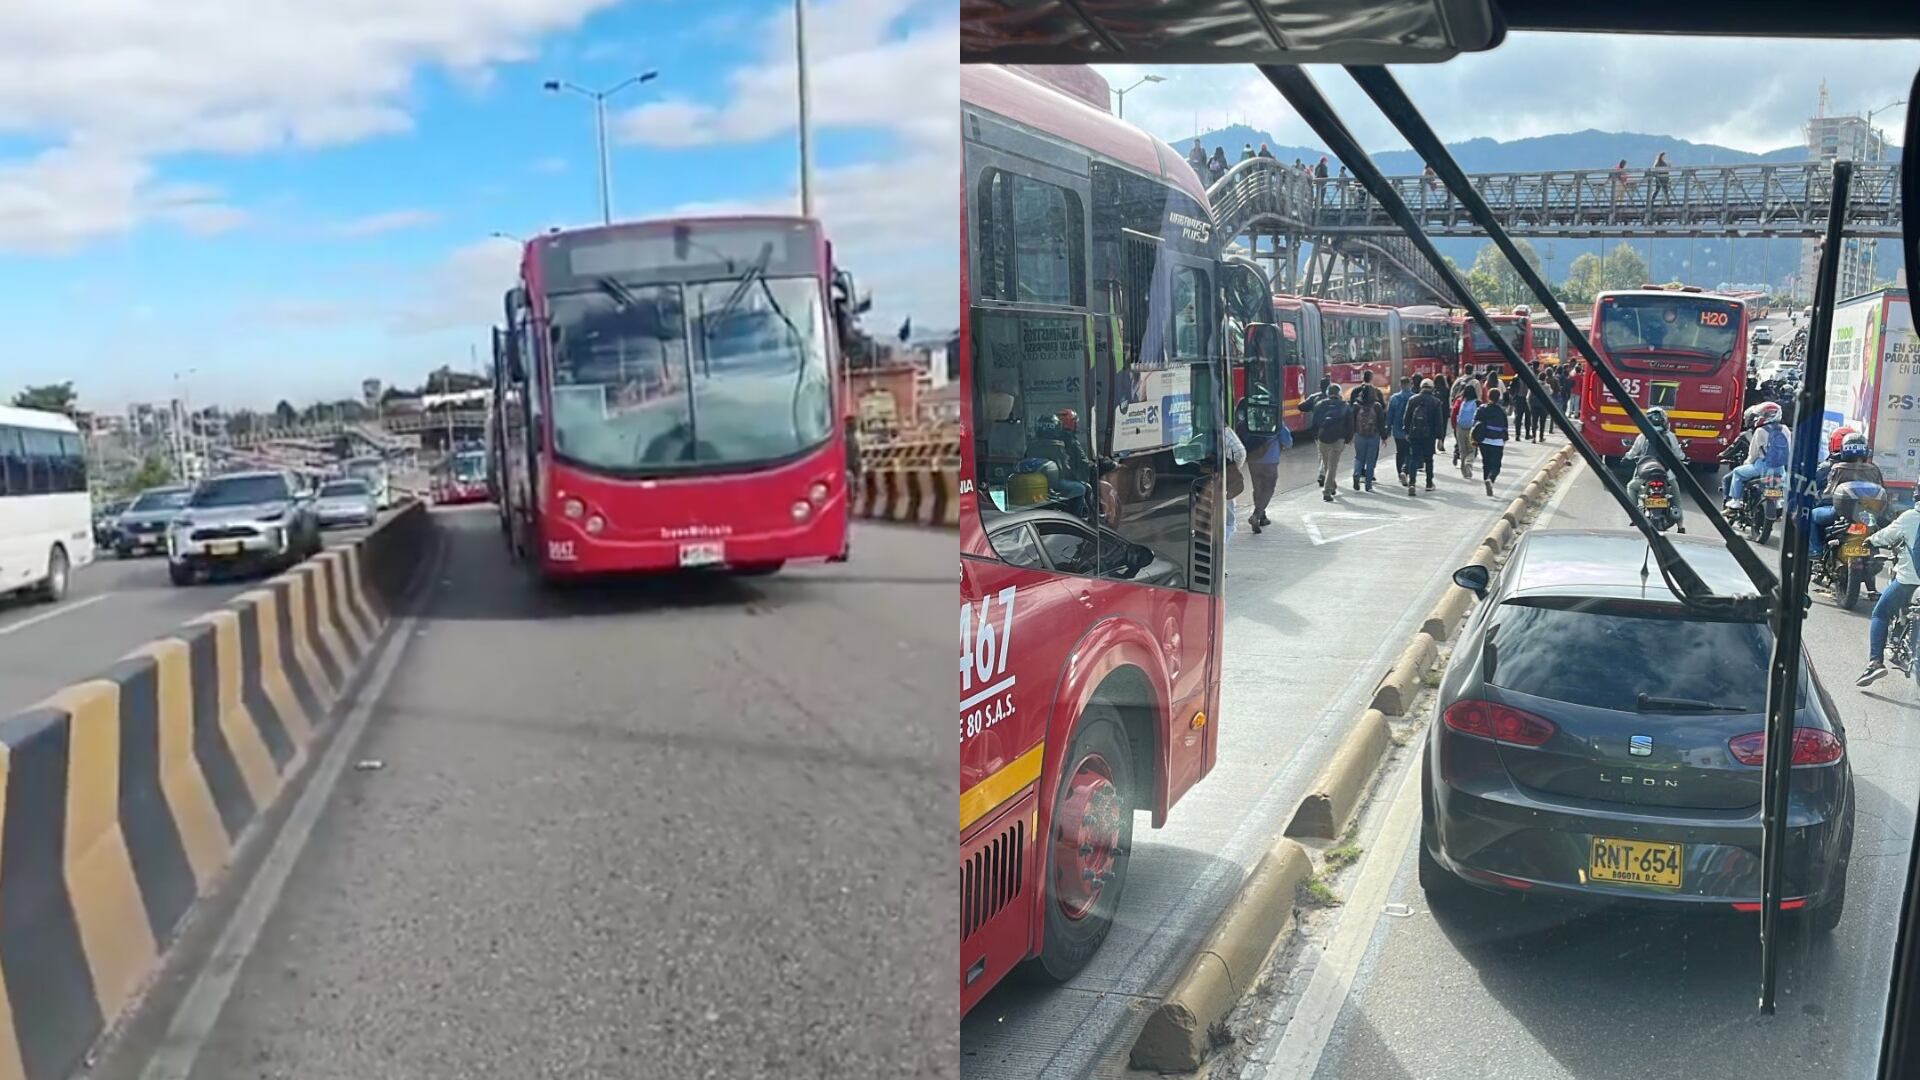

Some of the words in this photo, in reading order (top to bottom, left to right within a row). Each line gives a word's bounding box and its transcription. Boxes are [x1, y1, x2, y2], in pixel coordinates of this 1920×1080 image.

[1701, 311, 1728, 326] H20
[1893, 343, 1905, 353] EN
[1885, 353, 1909, 363] PARA
[1899, 364, 1910, 374] EN
[960, 585, 1017, 691] 467
[967, 709, 982, 738] 80
[985, 693, 1016, 728] S.A.S.
[1600, 773, 1678, 787] LEON
[1612, 870, 1641, 882] BOGOTA
